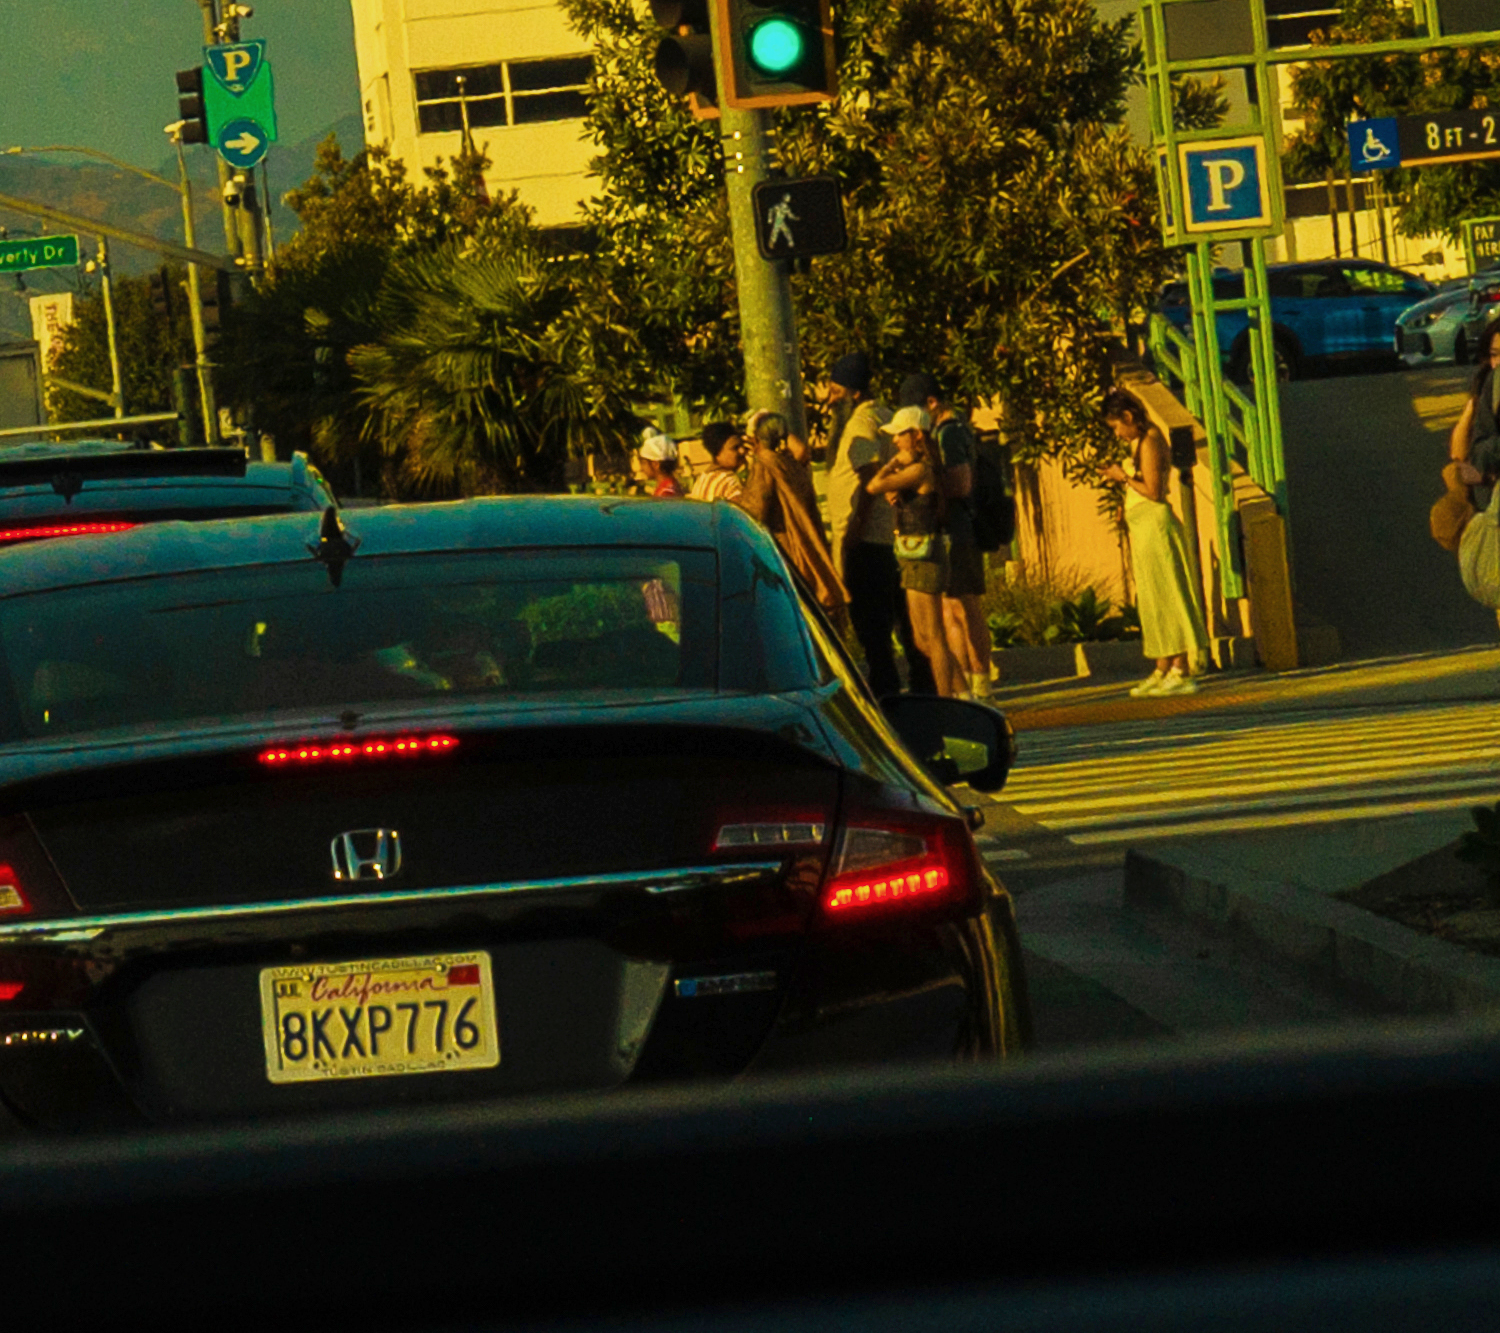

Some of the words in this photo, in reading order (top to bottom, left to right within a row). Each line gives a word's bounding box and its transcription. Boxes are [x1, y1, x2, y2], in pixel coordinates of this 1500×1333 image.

[222, 50, 252, 81] P
[1201, 158, 1245, 212] P
[44, 245, 65, 261] Dr
[310, 973, 450, 1004] California
[281, 997, 480, 1061] 8KXP776
